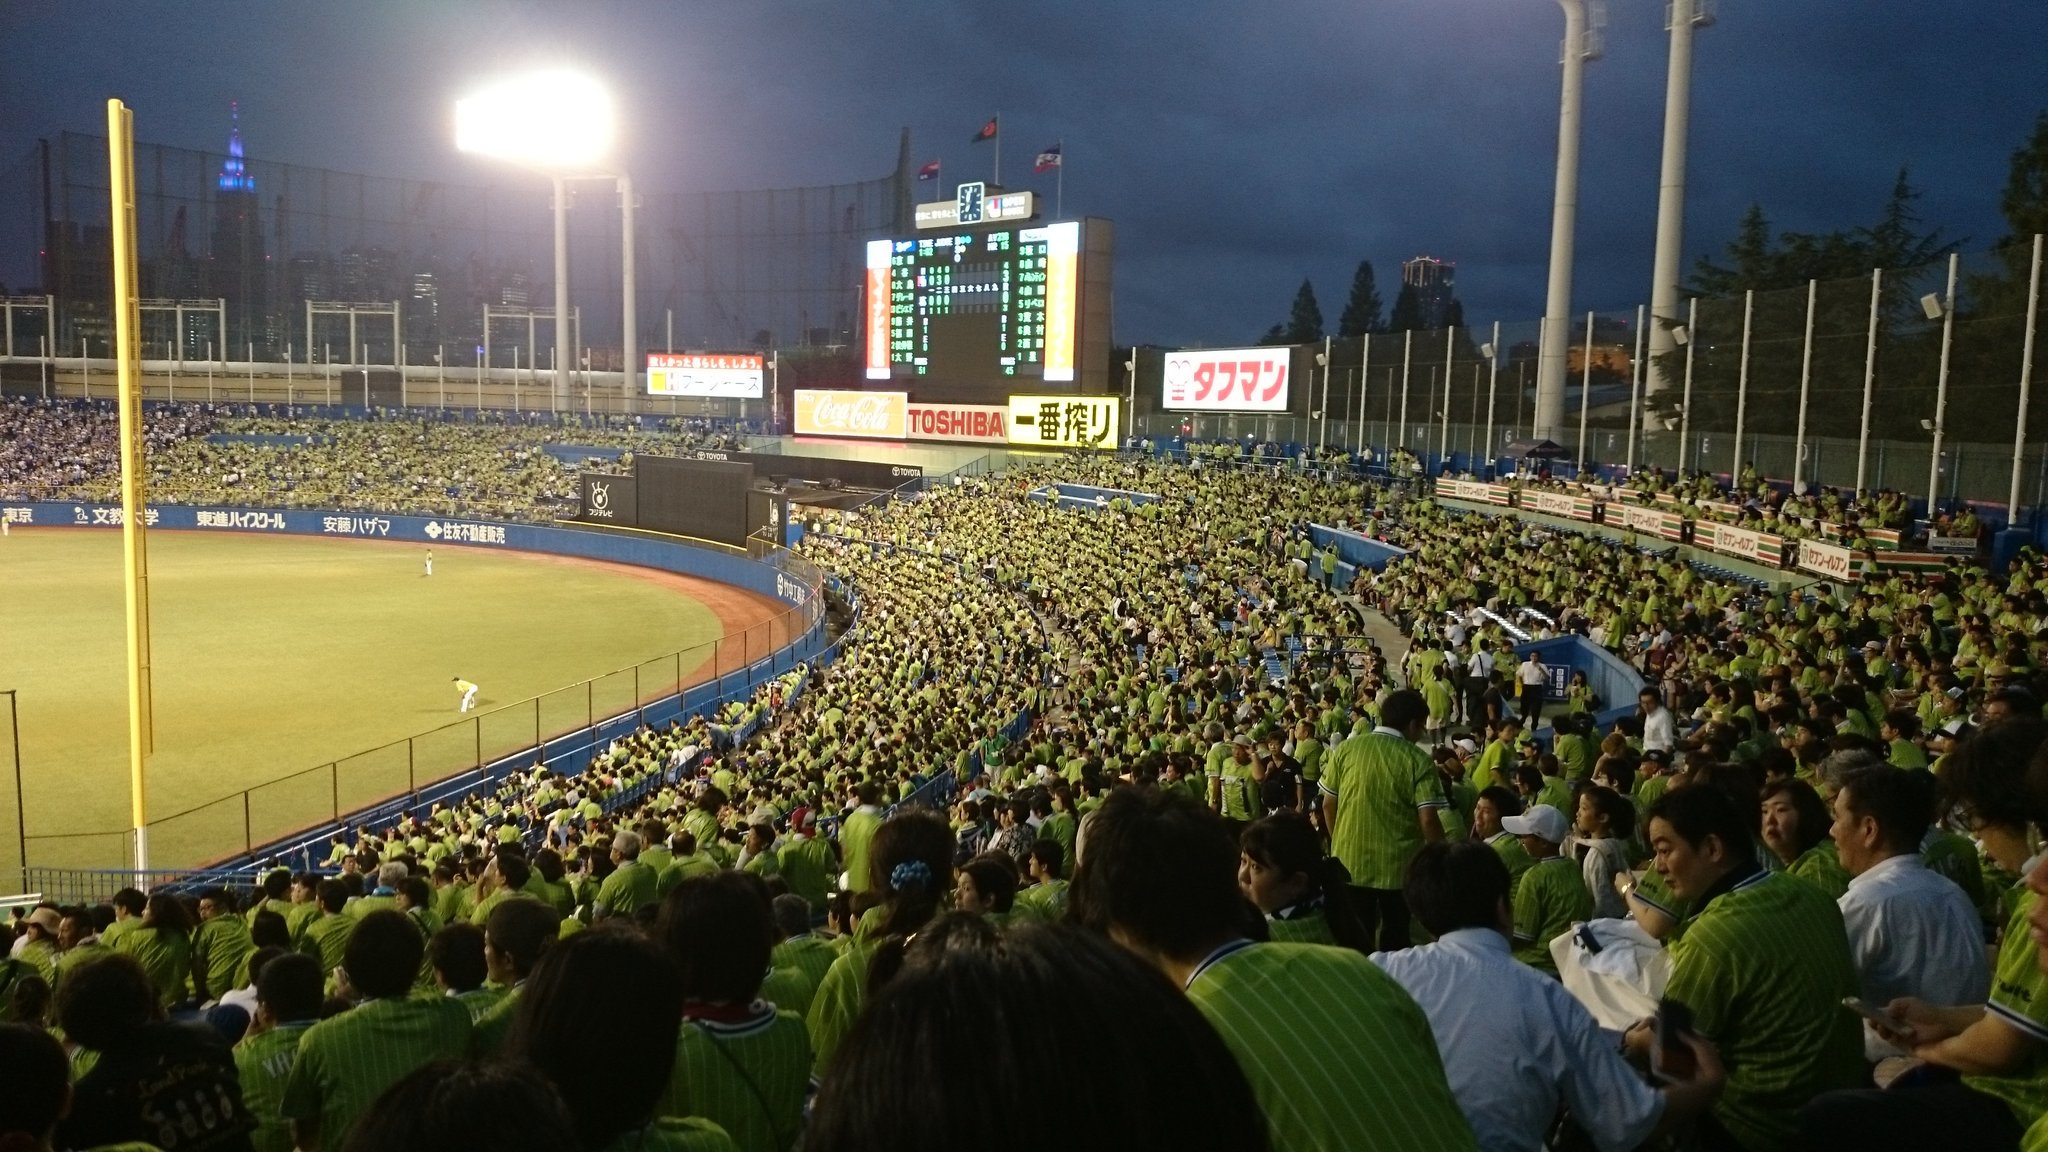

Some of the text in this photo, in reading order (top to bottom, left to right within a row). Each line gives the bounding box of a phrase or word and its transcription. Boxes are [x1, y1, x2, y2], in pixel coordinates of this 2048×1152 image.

[1194, 360, 1286, 401] タフマン
[908, 409, 1005, 437] TOSHIBA
[1015, 402, 1111, 442] 一番搾り
[706, 452, 728, 461] TOYOTA
[900, 467, 921, 477] TOYOTA
[3, 507, 33, 523] 東京
[196, 511, 286, 529] 東進ハイスクール
[588, 508, 613, 518] フジテレビ
[323, 517, 390, 536] 安藤ハザマ
[443, 522, 506, 544] 住友不動産販売
[262, 1049, 297, 1079] YA
